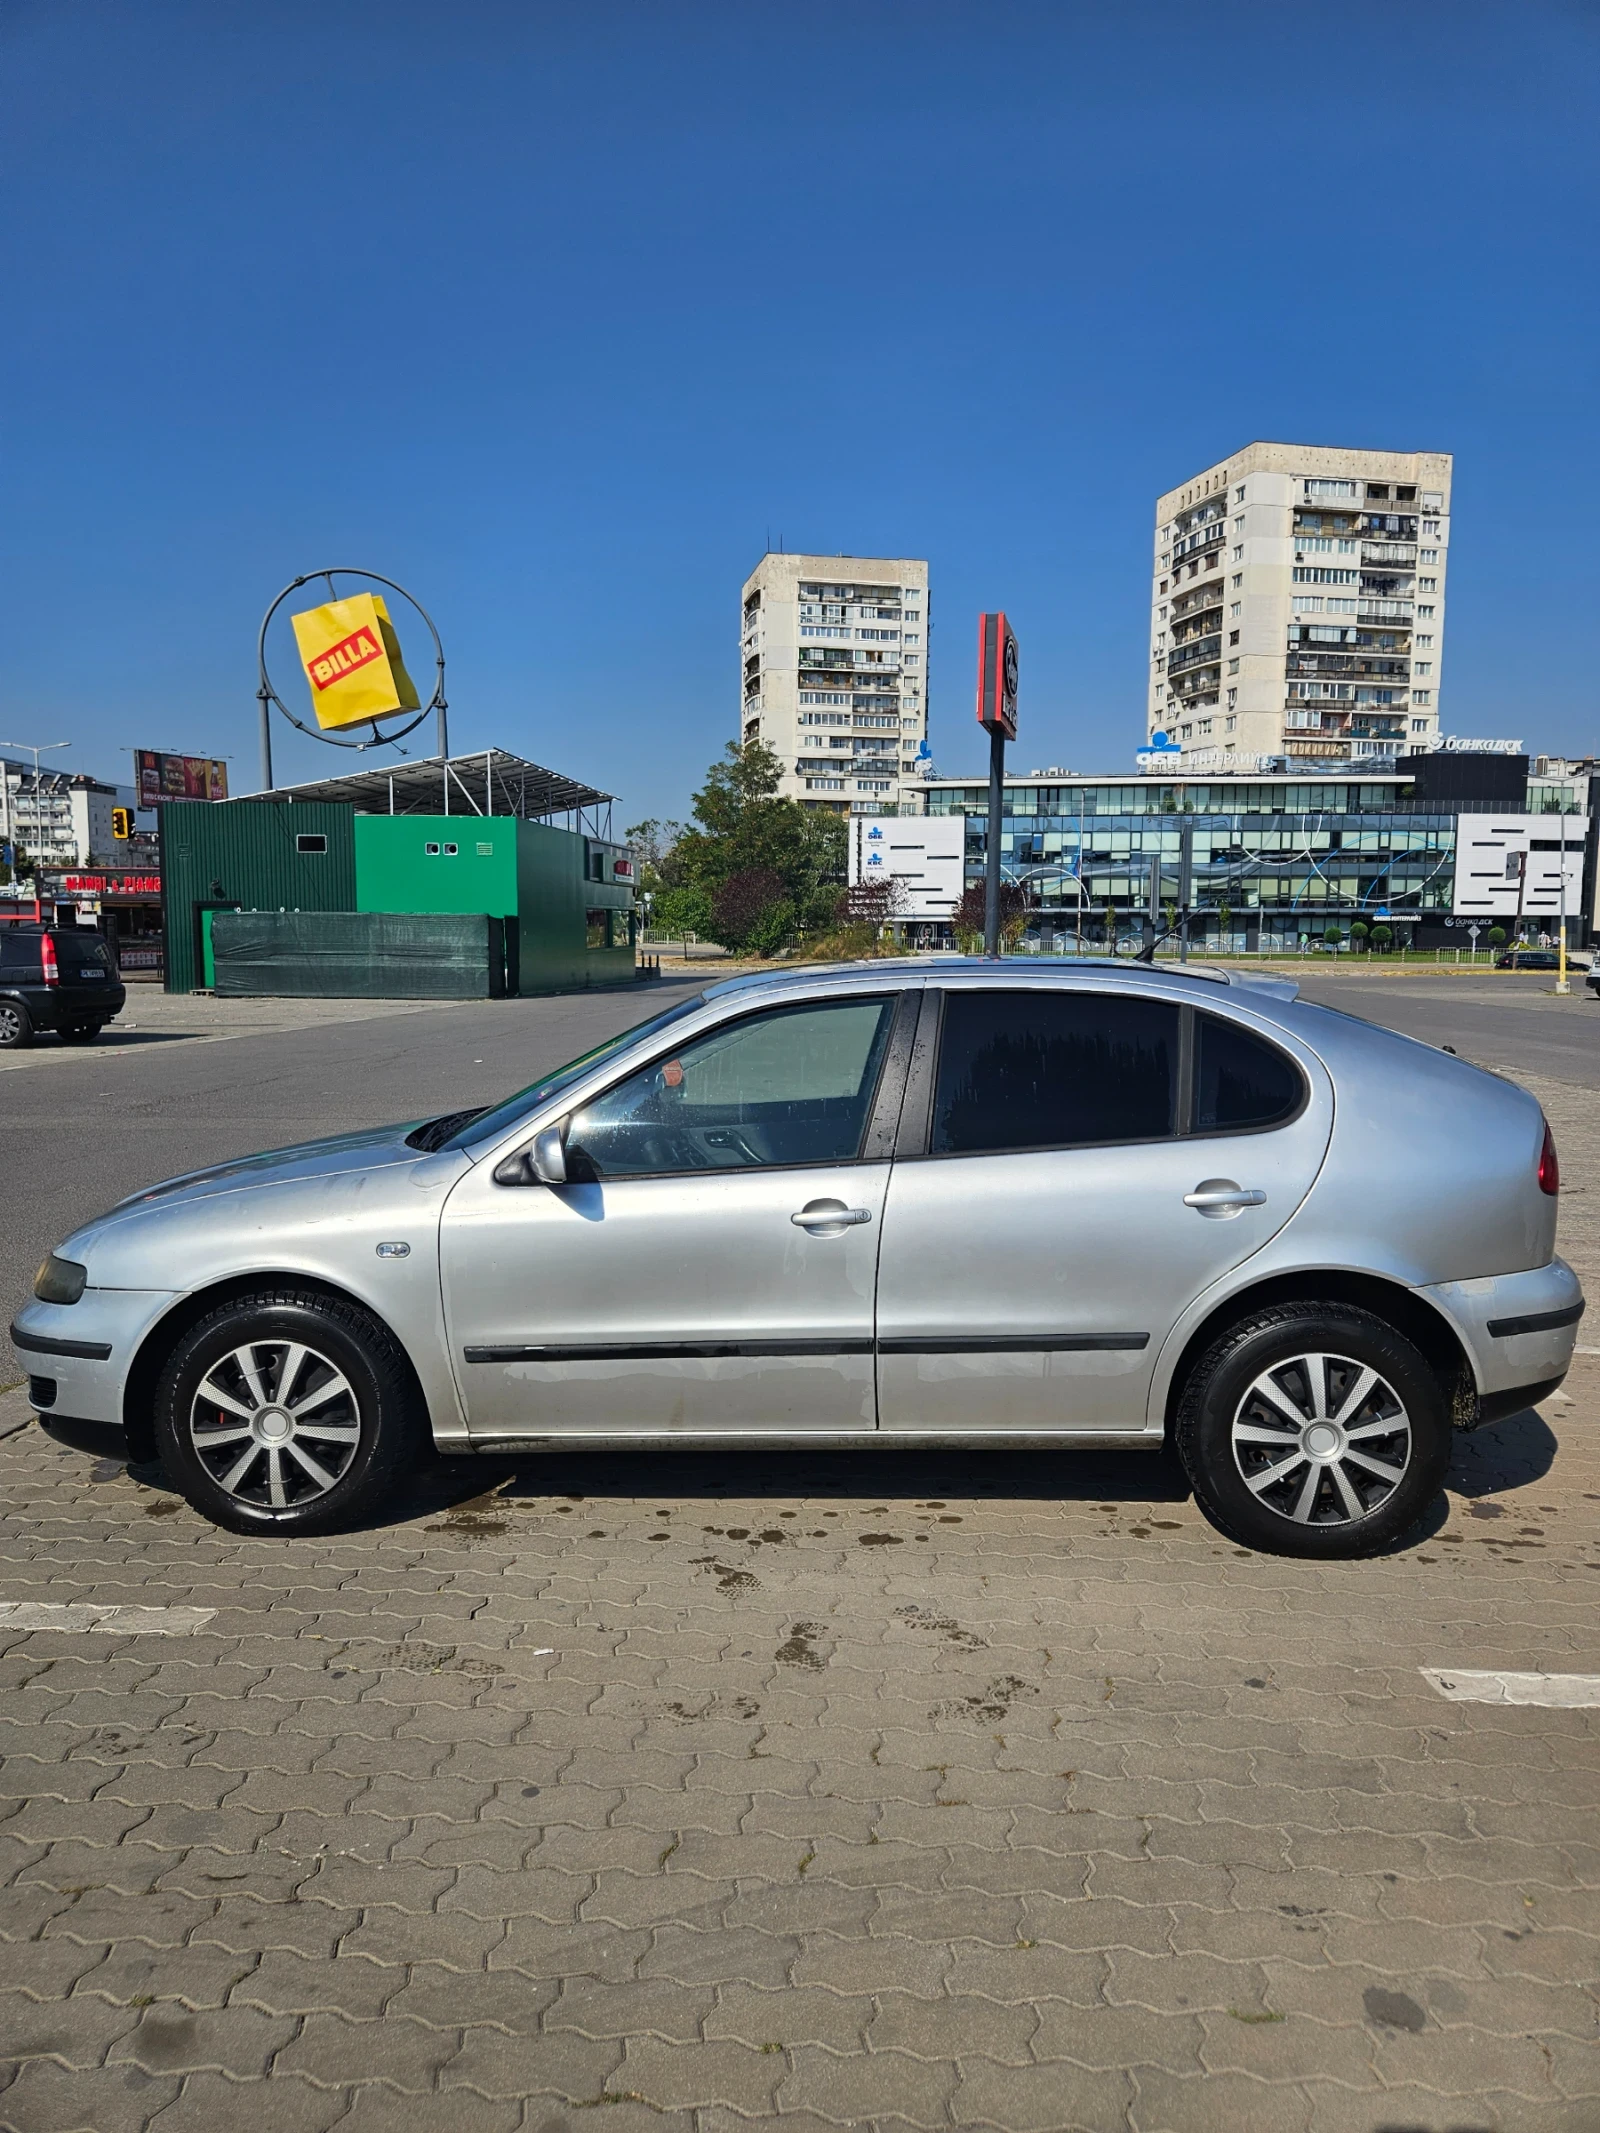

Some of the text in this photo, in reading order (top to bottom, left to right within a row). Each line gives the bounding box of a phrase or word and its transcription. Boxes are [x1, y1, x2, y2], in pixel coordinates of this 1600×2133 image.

[313, 635, 377, 683] BILLA
[1136, 750, 1269, 765] ОББ ИНТЕРЛИЙЗ
[111, 879, 119, 892] &
